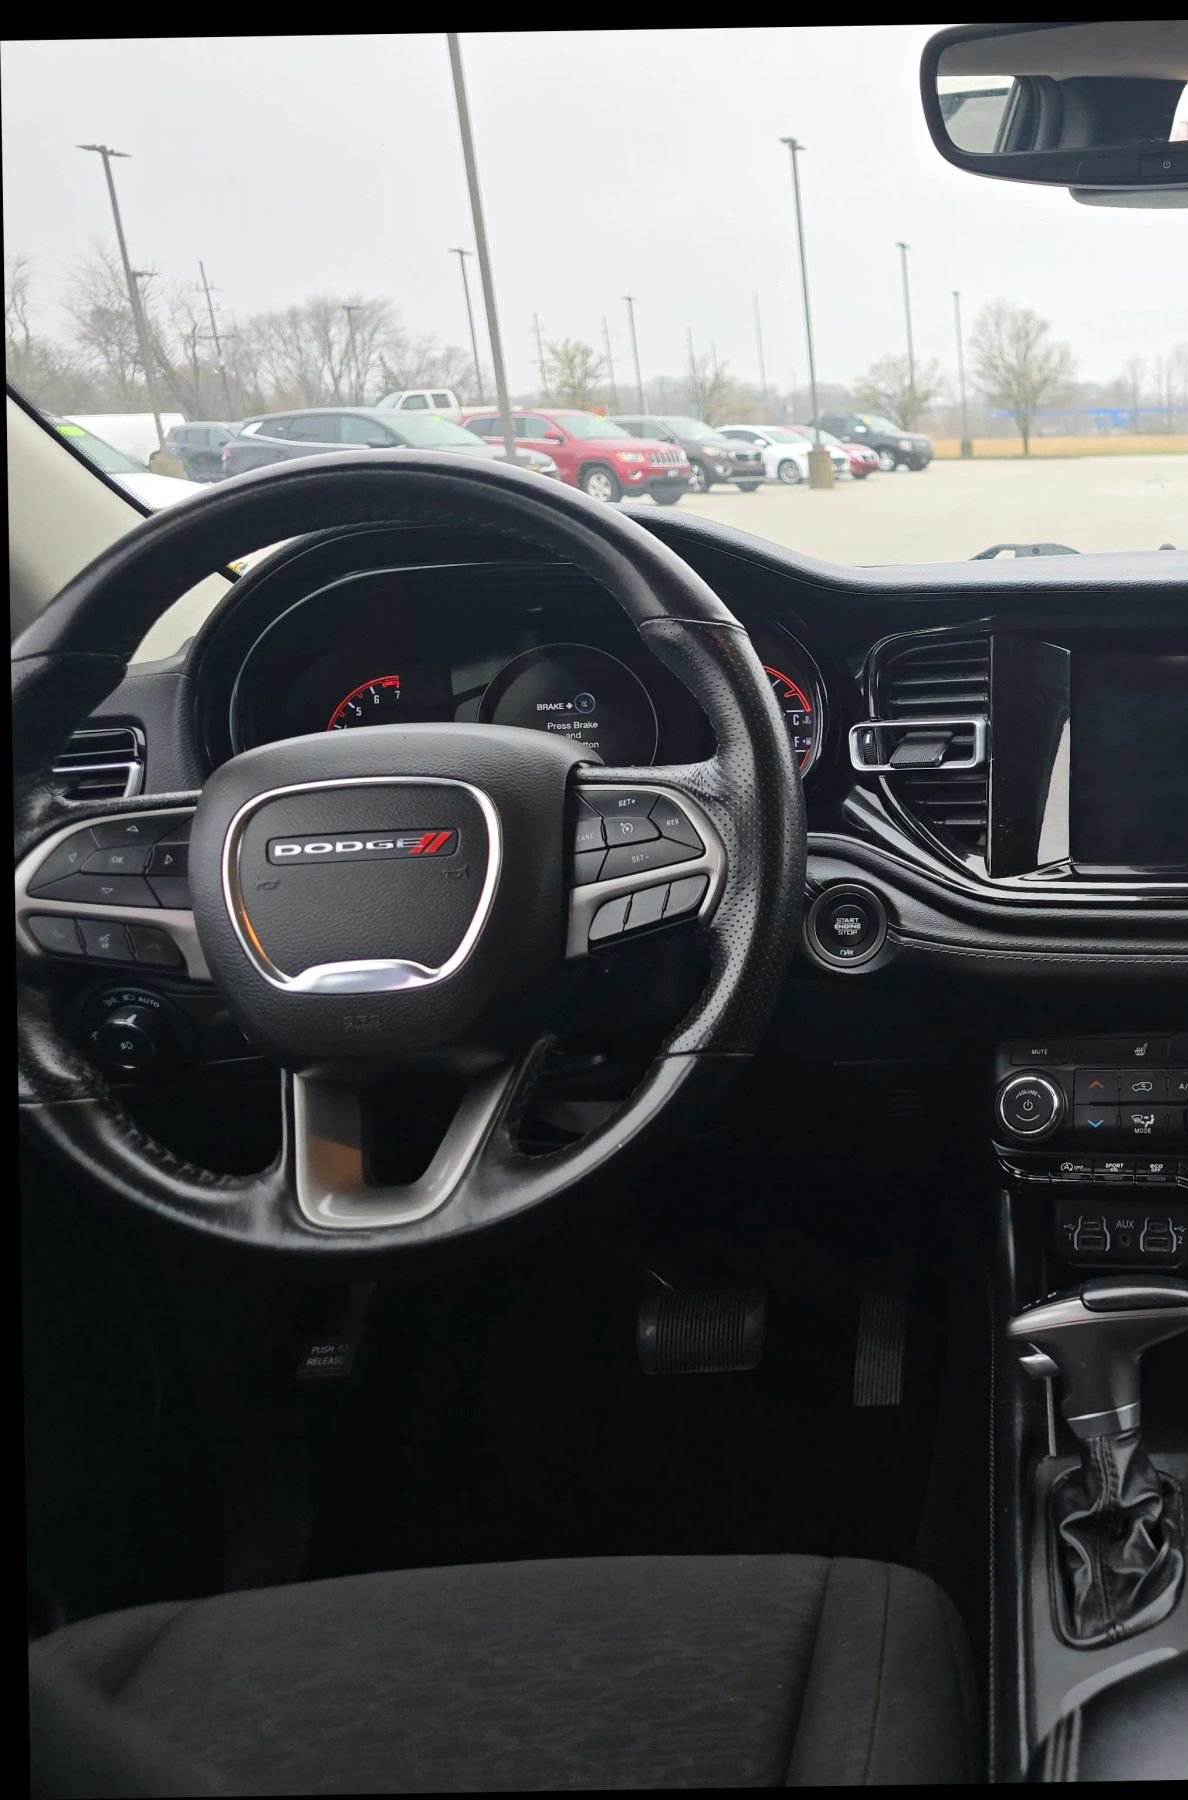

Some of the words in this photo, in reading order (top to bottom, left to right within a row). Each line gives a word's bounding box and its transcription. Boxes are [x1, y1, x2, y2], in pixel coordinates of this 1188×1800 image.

[373, 694, 380, 705] 6
[394, 690, 400, 700] 7
[355, 706, 362, 717] 5
[536, 703, 565, 711] BRAKE
[793, 714, 800, 726] C
[547, 722, 572, 730] Press
[573, 721, 599, 729] Brake
[565, 731, 582, 739] and
[793, 736, 800, 748] F
[666, 818, 680, 827] RES
[274, 838, 423, 857] DODGE
[111, 855, 125, 864] OK
[138, 996, 160, 1008] AUTO
[1116, 1220, 1135, 1229] AUX
[1177, 1235, 1183, 1244] 2
[311, 1345, 335, 1354] PUSH
[338, 1344, 350, 1353] TO
[306, 1356, 345, 1366] RELEASE
